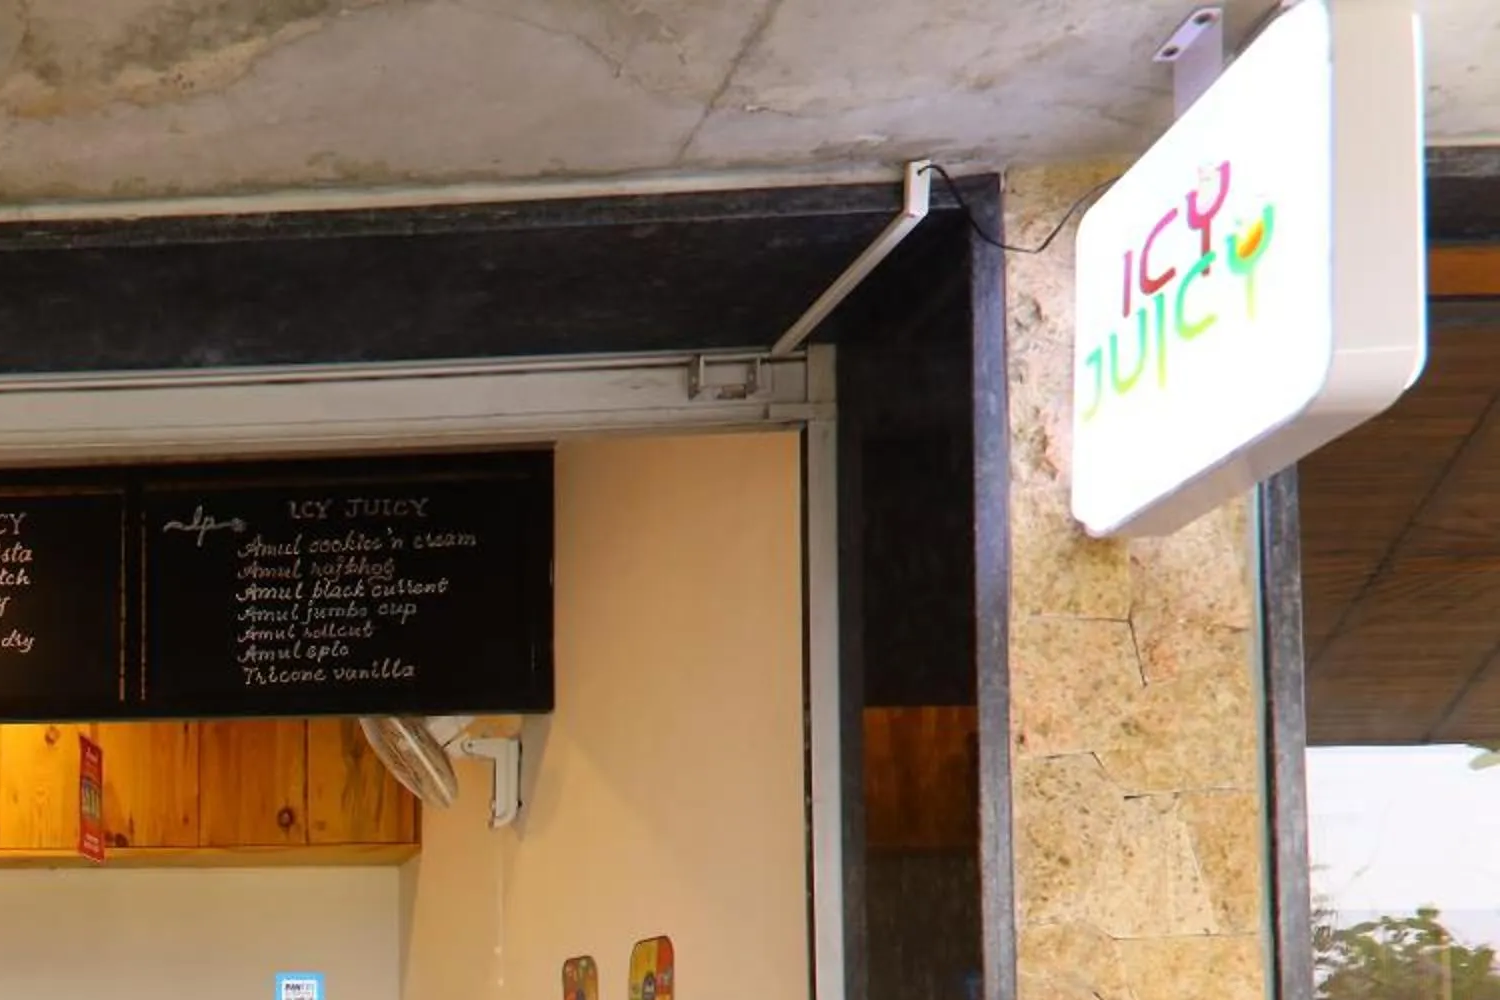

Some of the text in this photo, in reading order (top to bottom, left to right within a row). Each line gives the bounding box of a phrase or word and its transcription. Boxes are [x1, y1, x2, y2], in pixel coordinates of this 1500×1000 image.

[1122, 160, 1231, 319] ICY
[1082, 203, 1275, 423] JUICY
[345, 498, 430, 518] JUICY
[237, 534, 299, 558] Amul
[237, 557, 303, 579] Amul
[235, 580, 303, 601] Amul
[312, 578, 366, 600] black
[237, 599, 417, 624] Amul jumbo cup
[237, 624, 296, 643] Amul
[237, 640, 301, 663] Amul
[333, 657, 415, 680] vanilla
